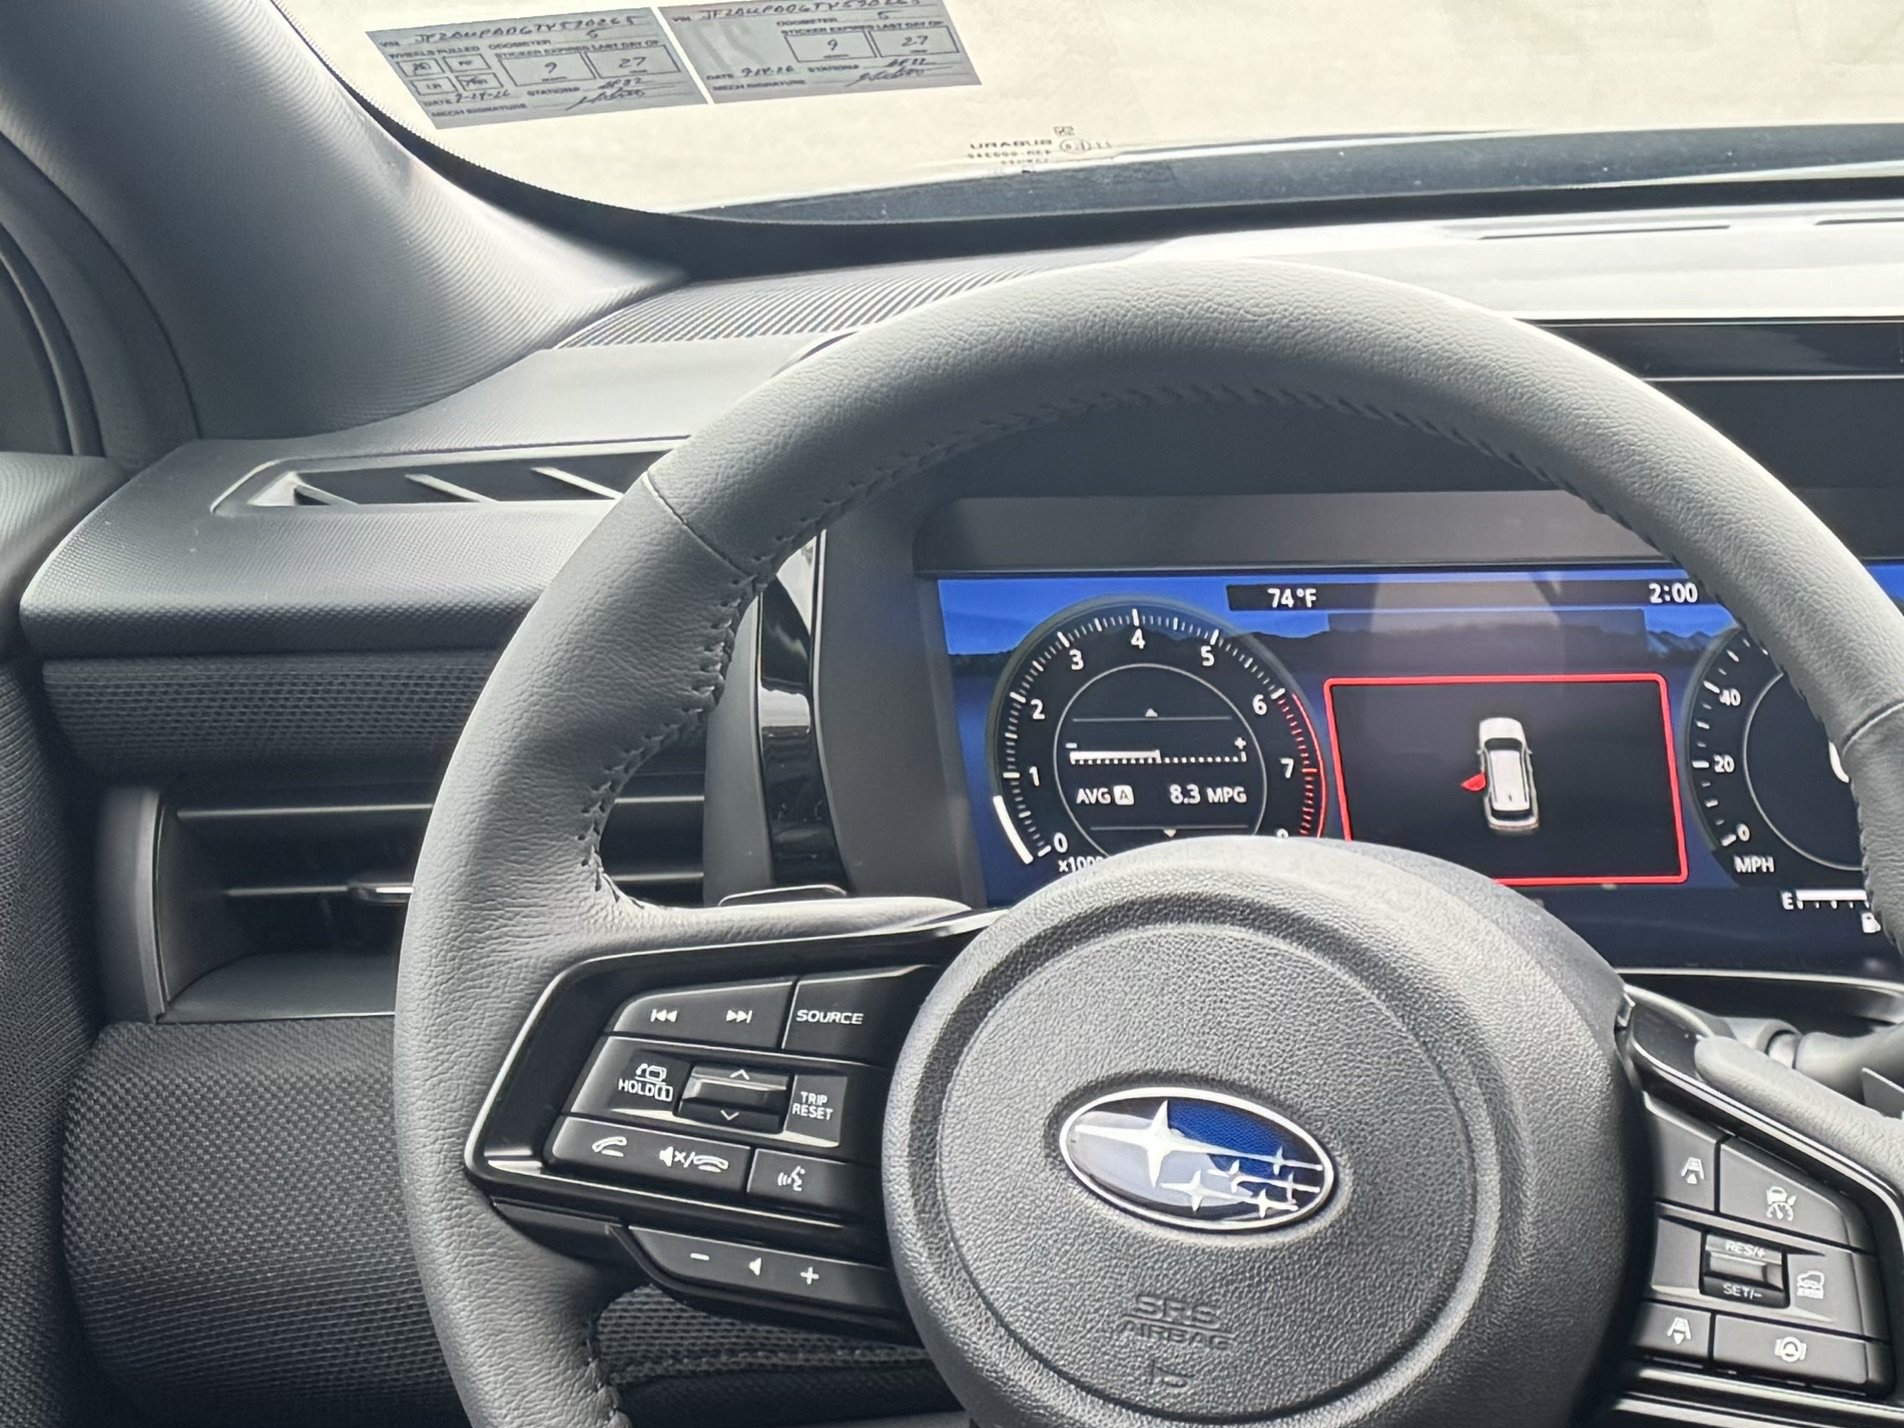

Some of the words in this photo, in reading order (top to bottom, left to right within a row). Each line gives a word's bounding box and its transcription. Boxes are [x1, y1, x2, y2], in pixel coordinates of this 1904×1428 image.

[1649, 582, 1698, 603] 2:00
[1130, 628, 1145, 649] 4
[1069, 649, 1083, 670] 3
[1200, 645, 1214, 666] 5
[1252, 694, 1267, 715] 6
[1717, 688, 1740, 706] 40
[1030, 699, 1045, 719] 2
[1280, 758, 1294, 778] 7
[1714, 755, 1734, 772] 20
[1029, 766, 1039, 786] 1
[1076, 788, 1111, 803] AVG
[1170, 784, 1200, 803] 8.3
[1206, 786, 1247, 803] MPG
[1053, 832, 1068, 853] 0
[1736, 825, 1750, 841] 0
[1734, 855, 1774, 872] MPH
[1781, 892, 1793, 909] E
[796, 1009, 863, 1024] SOURCE
[618, 1077, 657, 1097] HOLD
[798, 1091, 828, 1107] TRIP
[792, 1105, 833, 1120] RESET
